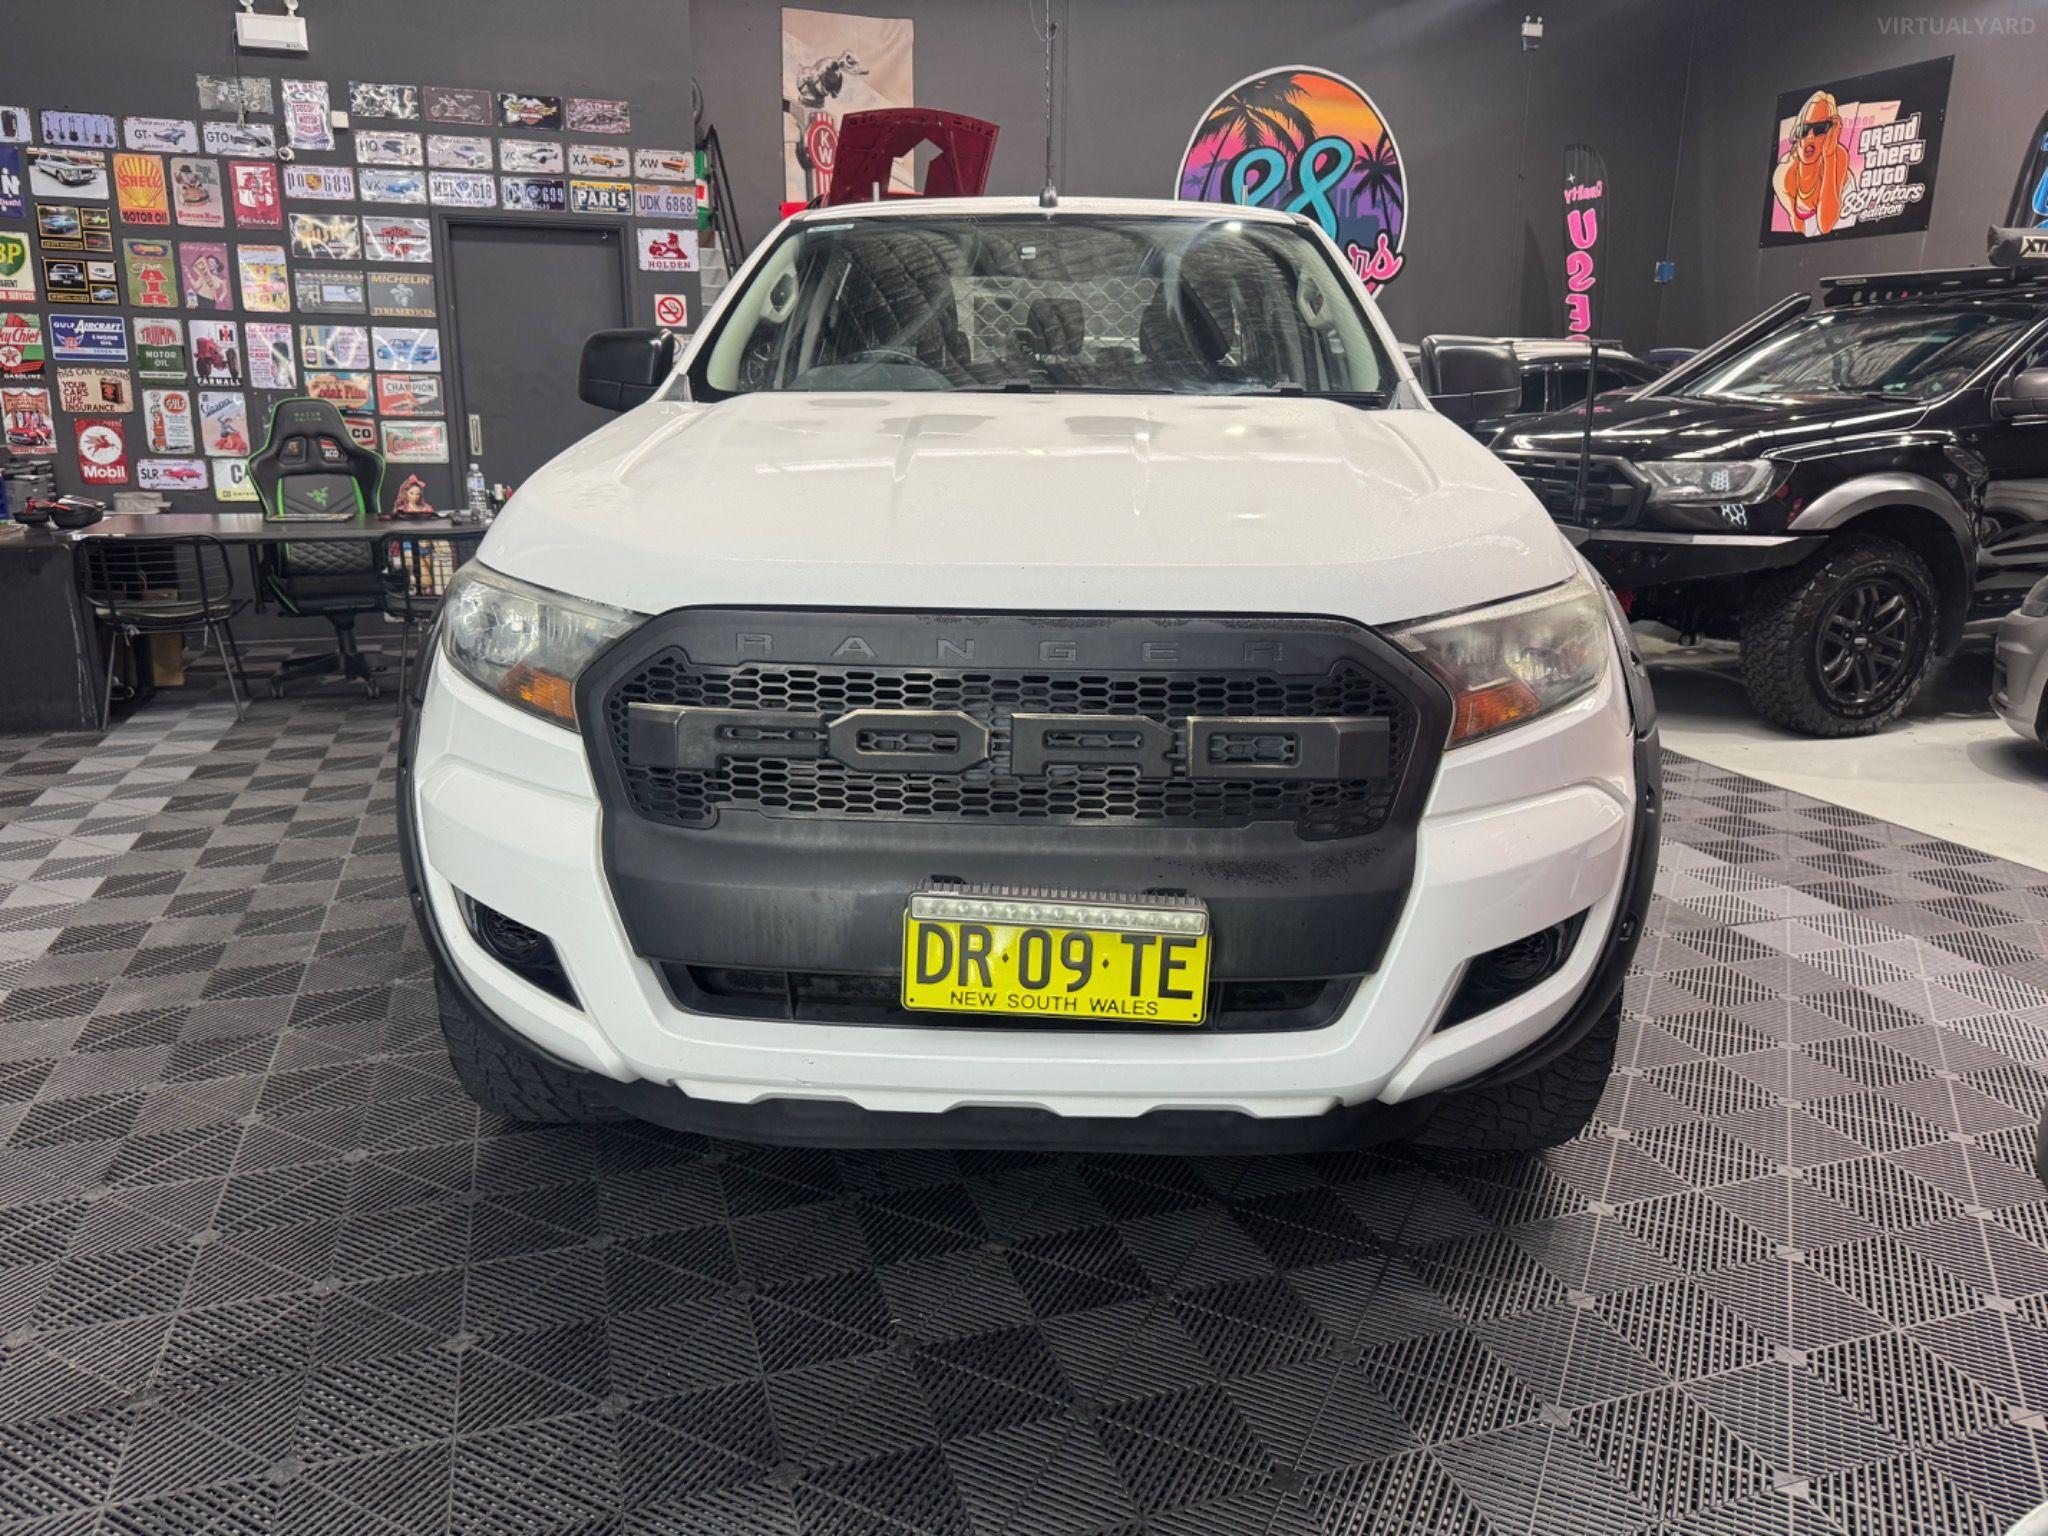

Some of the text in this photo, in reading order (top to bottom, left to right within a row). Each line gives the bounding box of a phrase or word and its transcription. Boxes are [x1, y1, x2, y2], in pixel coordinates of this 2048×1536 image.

[577, 190, 627, 207] PARIS
[639, 195, 693, 212] UDK 6868
[371, 274, 430, 284] MICHELIN
[53, 319, 122, 333] GULF AIRCRAFT
[146, 351, 177, 359] MOTOR
[76, 368, 93, 376] CAN
[198, 378, 241, 386] FARMALL
[386, 382, 434, 393] CHAMPION
[66, 404, 114, 412] INSURANCE
[82, 466, 126, 478] Mobil
[736, 632, 1284, 663] RANGER
[628, 702, 1390, 780] FORD
[950, 990, 1159, 1017] NEW SOUTH WALES
